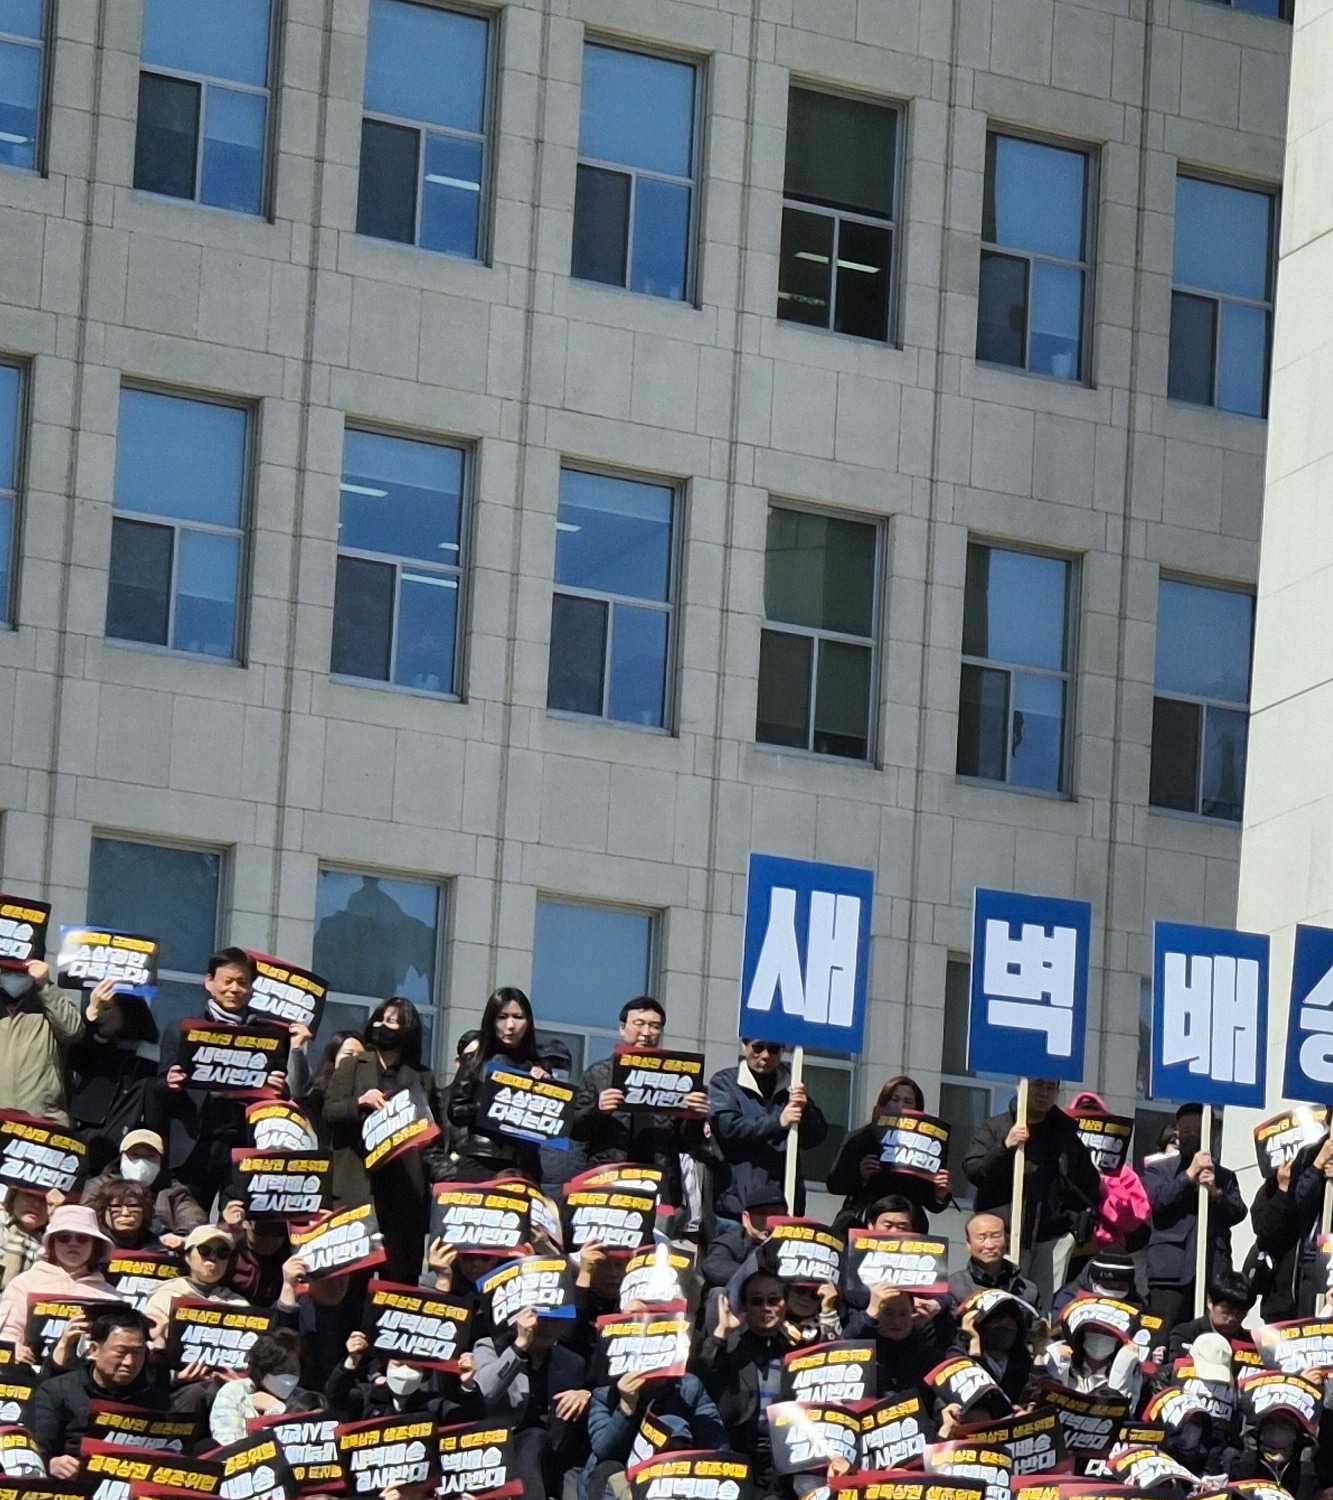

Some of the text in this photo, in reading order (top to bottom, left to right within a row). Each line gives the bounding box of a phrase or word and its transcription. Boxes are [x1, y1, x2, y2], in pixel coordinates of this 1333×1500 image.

[749, 885, 858, 1028] 새
[983, 919, 1077, 1059] 벽
[1161, 953, 1258, 1088] 배
[374, 1329, 456, 1360] 결사반대
[376, 1309, 457, 1340] 새벽배송
[645, 1478, 740, 1500] 새벽배송
